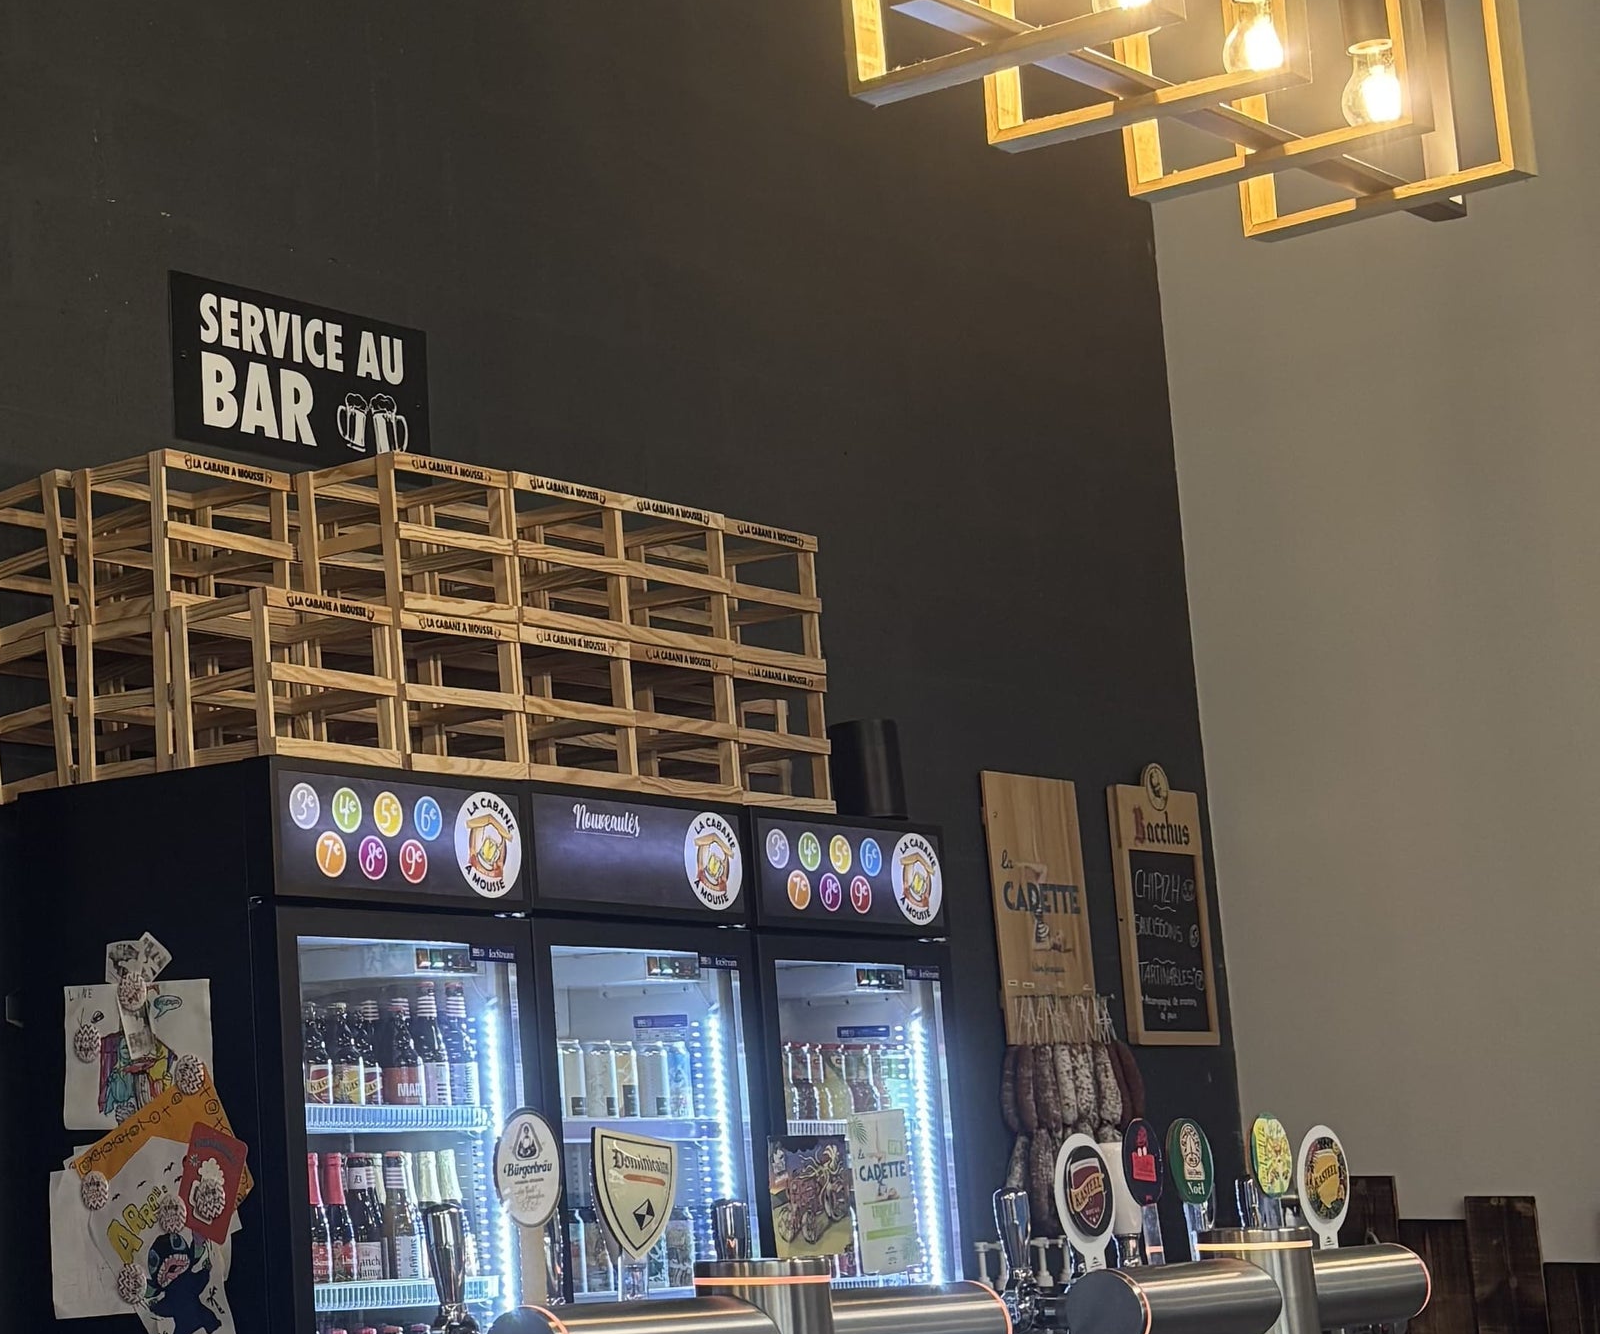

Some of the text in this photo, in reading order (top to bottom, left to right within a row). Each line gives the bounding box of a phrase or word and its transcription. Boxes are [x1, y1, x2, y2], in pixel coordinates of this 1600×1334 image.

[200, 293, 404, 385] SERVICE AU
[201, 351, 318, 447] BAR
[466, 798, 515, 832] LA CABANE
[573, 803, 640, 837] Nouveautés
[1133, 805, 1190, 847] Bacchus
[695, 817, 735, 849] LA CABANE
[472, 873, 506, 893] MOUSSE
[1004, 881, 1081, 914] CADETTE
[860, 1160, 907, 1182] CADETTE
[1314, 1162, 1339, 1190] KASTEEL
[1075, 1173, 1104, 1211] KASTEEL
[1187, 1180, 1206, 1196] Noël
